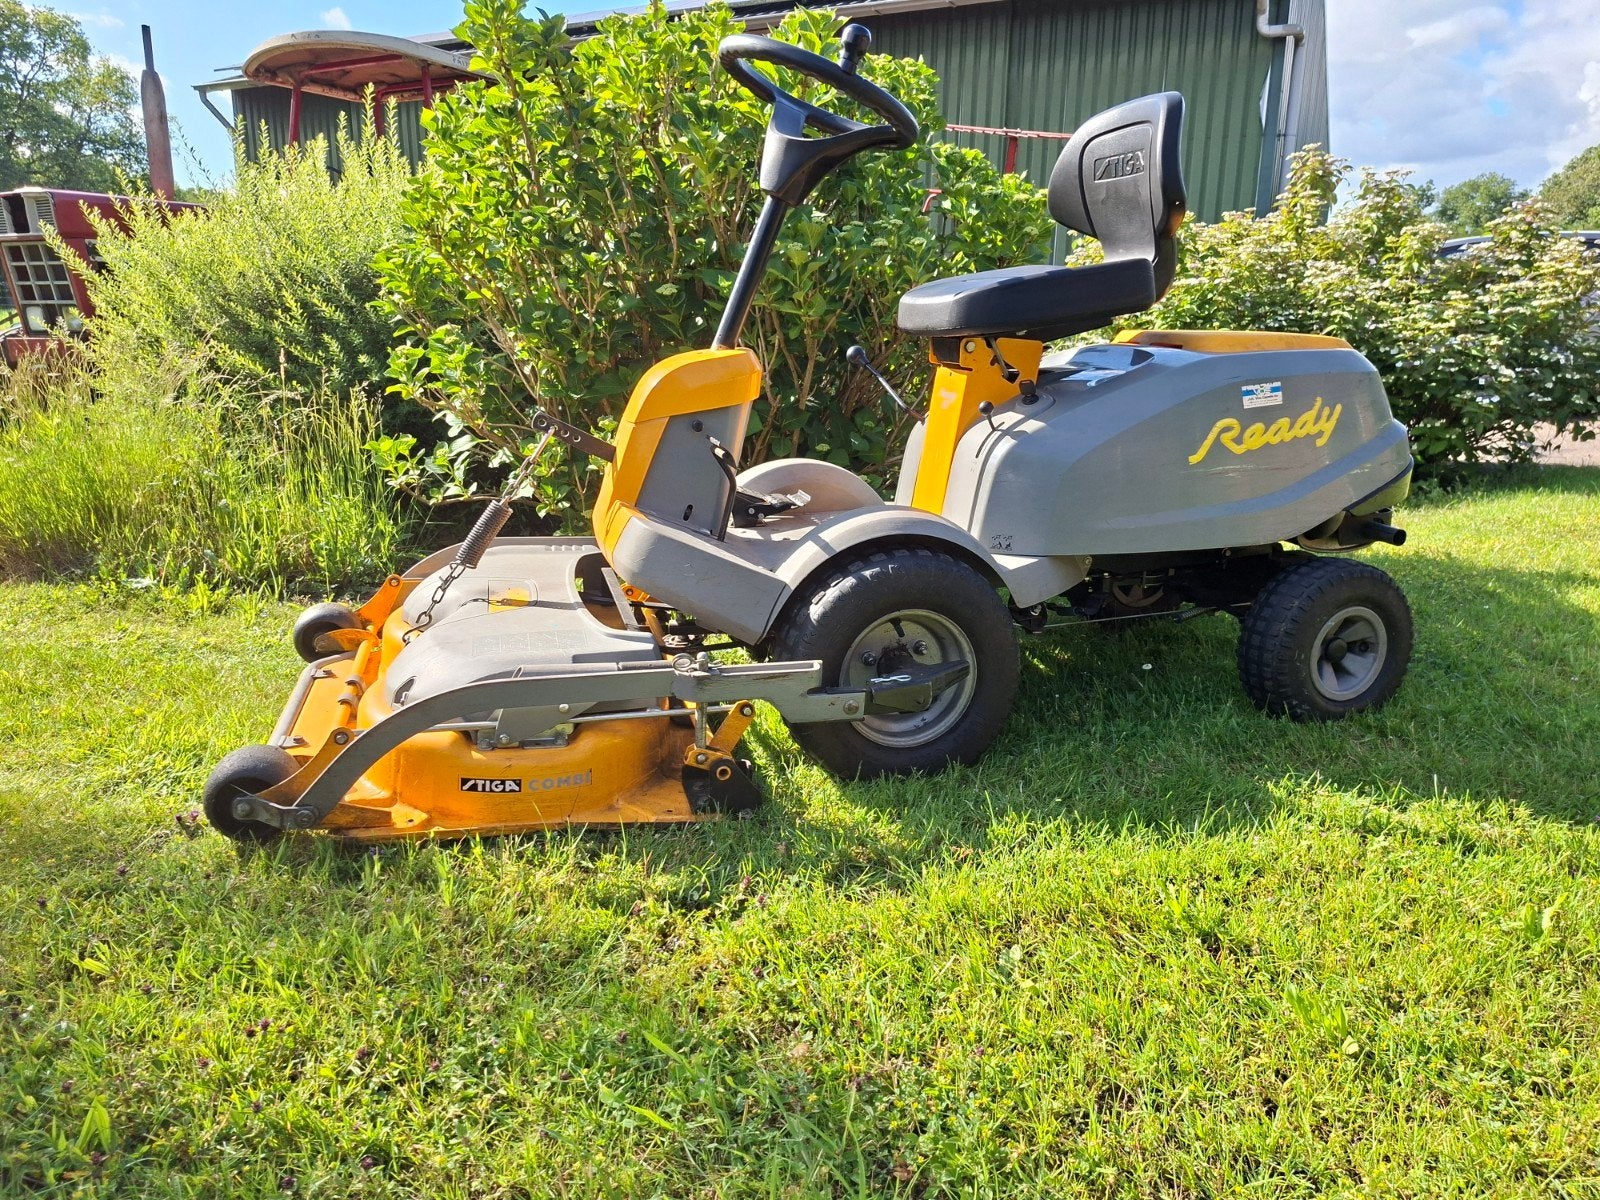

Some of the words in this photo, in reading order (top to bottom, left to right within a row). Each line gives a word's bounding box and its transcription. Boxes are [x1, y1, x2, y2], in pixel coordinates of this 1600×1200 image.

[1095, 150, 1145, 180] STIGA
[1188, 396, 1342, 465] Ready
[462, 779, 520, 792] STIGA
[528, 771, 591, 792] COMBI
